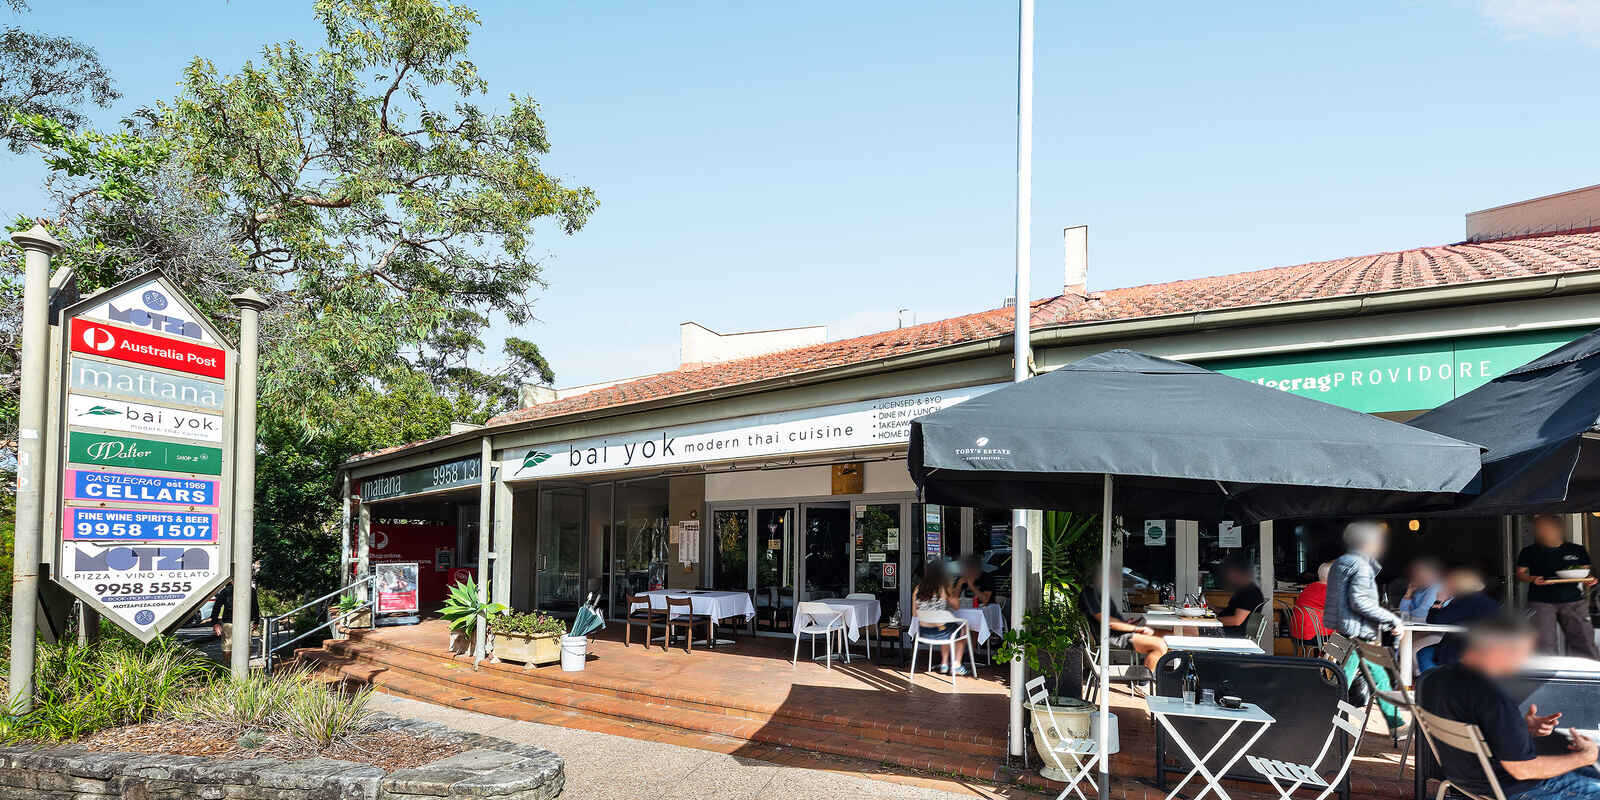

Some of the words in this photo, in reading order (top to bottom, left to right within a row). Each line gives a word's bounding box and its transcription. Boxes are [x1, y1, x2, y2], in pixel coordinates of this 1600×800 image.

[120, 340, 184, 361] Australia
[187, 353, 217, 368] Post
[1333, 360, 1492, 387] PROVIDORE
[80, 367, 216, 406] mattana
[878, 399, 915, 410] LICENSED
[917, 398, 922, 406] &
[925, 396, 942, 405] BYO
[126, 406, 162, 424] bai
[173, 417, 213, 431] yok
[878, 411, 896, 420] DINE
[898, 410, 907, 418] IN
[878, 420, 911, 430] TAKEAWA
[878, 430, 902, 440] HOME
[87, 441, 152, 460] Walter
[569, 440, 607, 466] bai
[624, 432, 675, 466] yok
[684, 437, 739, 453] modern
[748, 431, 779, 446] thai
[789, 425, 854, 442] cuisine
[86, 474, 161, 487] CASTLECRAG
[166, 480, 182, 488] est
[184, 481, 206, 490] 1969
[364, 475, 401, 499] mattana
[433, 464, 458, 486] 9958
[462, 458, 481, 481] 131
[85, 484, 206, 503] CELLARS
[78, 512, 103, 521] FINE
[106, 513, 133, 522] WINE
[136, 514, 172, 523] SPIRITS
[176, 515, 183, 523] &
[185, 515, 209, 524] BEER
[77, 522, 142, 536] 9958
[153, 525, 210, 537] 1507
[75, 547, 209, 572] MOTZA
[74, 573, 111, 581] PIZZA
[95, 583, 143, 595] 9958
[149, 582, 192, 593] 5555
